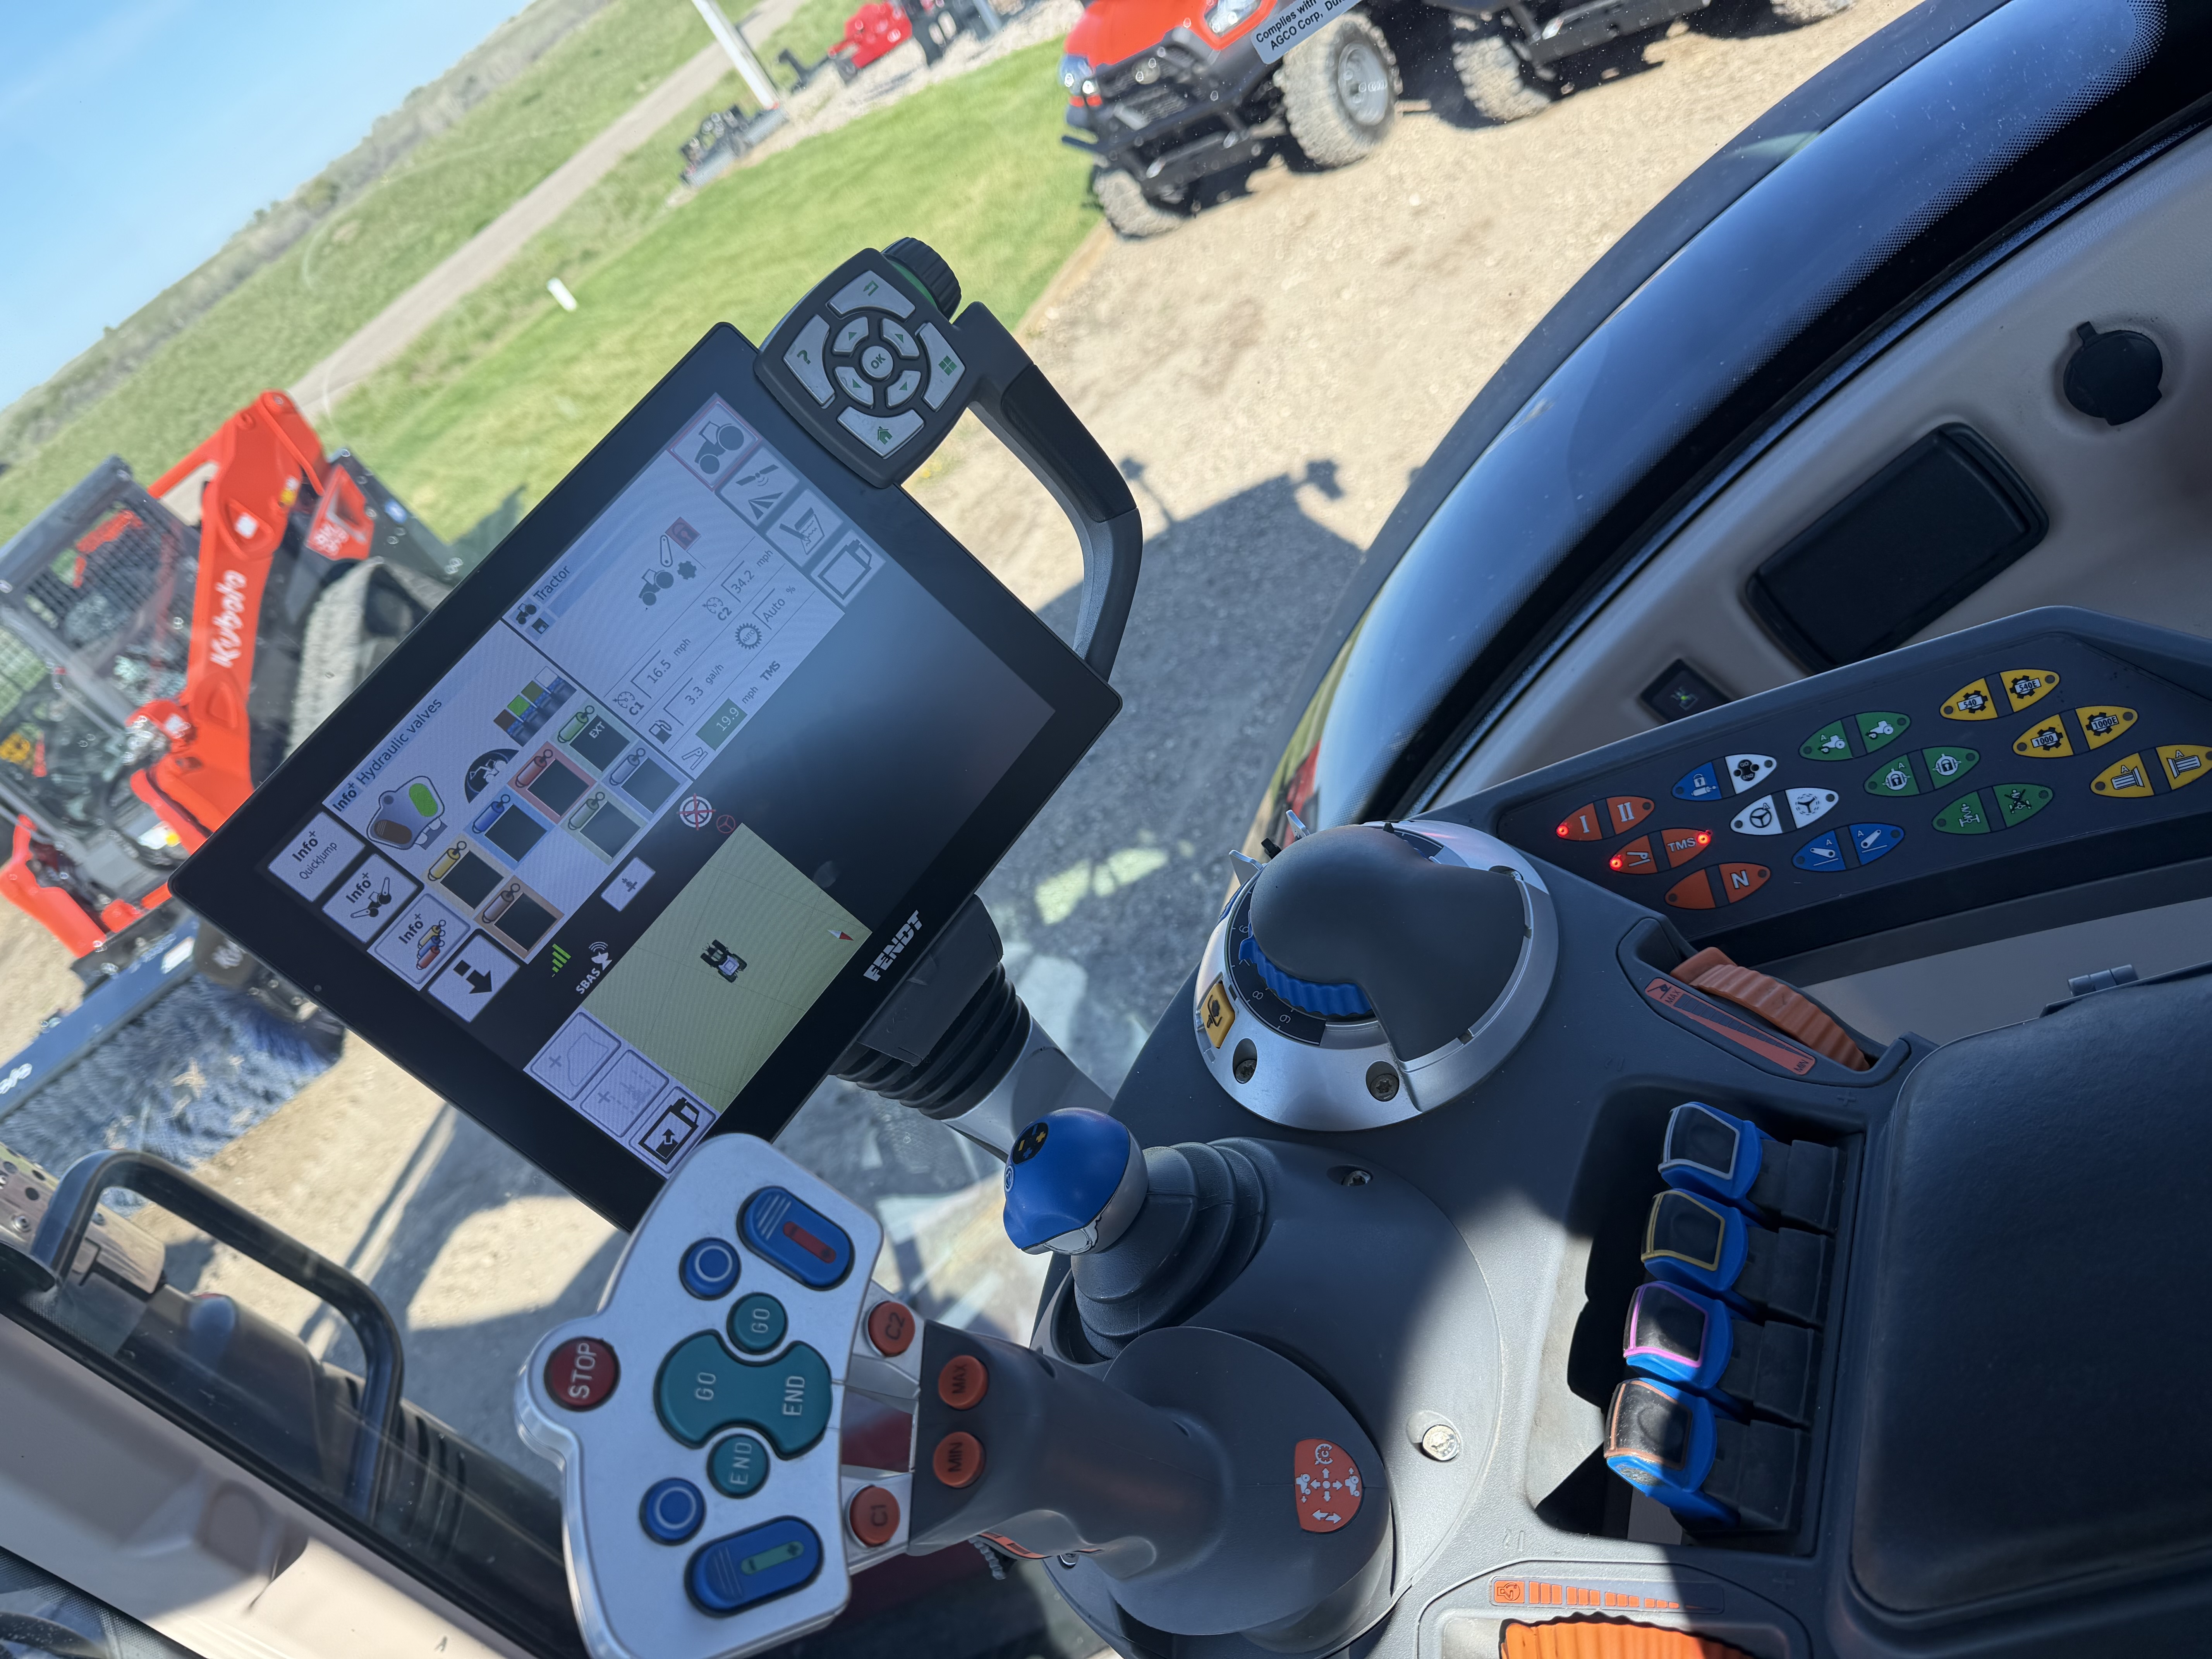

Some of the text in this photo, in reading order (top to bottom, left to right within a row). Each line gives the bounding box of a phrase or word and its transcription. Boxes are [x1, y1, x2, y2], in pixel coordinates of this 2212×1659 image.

[1256, 0, 1316, 43] Complies with
[1270, 0, 1345, 51] AGCO Corp, Du
[871, 354, 886, 369] OK
[533, 565, 571, 601] Tractor
[731, 550, 773, 594] 34.2 mph
[718, 607, 732, 621] C2
[763, 586, 795, 622] Auto %
[210, 570, 247, 668] Kubota
[742, 629, 755, 643] AUTO
[646, 637, 691, 685] 16.5 mph
[759, 661, 781, 683] TMS
[684, 663, 725, 706] 3.3 gal/h
[2019, 681, 2037, 690] 540E
[629, 701, 644, 715] C1
[716, 685, 759, 732] 19.9 mph
[1963, 699, 1977, 708] 540
[589, 722, 605, 739] EXT
[2093, 717, 2117, 728] 1000E
[358, 733, 409, 785] Hydraulic
[406, 698, 443, 734] valves
[2035, 735, 2053, 745] 1000
[1667, 837, 1695, 853] TMS
[299, 842, 337, 880] QuickJump
[1730, 871, 1749, 889] N
[1239, 925, 1249, 933] 6
[863, 909, 923, 982] FENDT
[575, 967, 601, 995] SBAS
[1252, 990, 1263, 1000] 8
[1665, 989, 1681, 1004] MAX
[1279, 1014, 1291, 1024] 9
[1793, 1059, 1809, 1072] MIN
[751, 1307, 770, 1334] GO
[884, 1312, 905, 1340] C2
[569, 1342, 596, 1400] STOP
[952, 1364, 967, 1394] MAX
[695, 1372, 716, 1401] GO
[783, 1375, 805, 1416] END
[730, 1441, 752, 1485] END
[948, 1441, 963, 1472] MIN
[870, 1503, 888, 1527] C1
